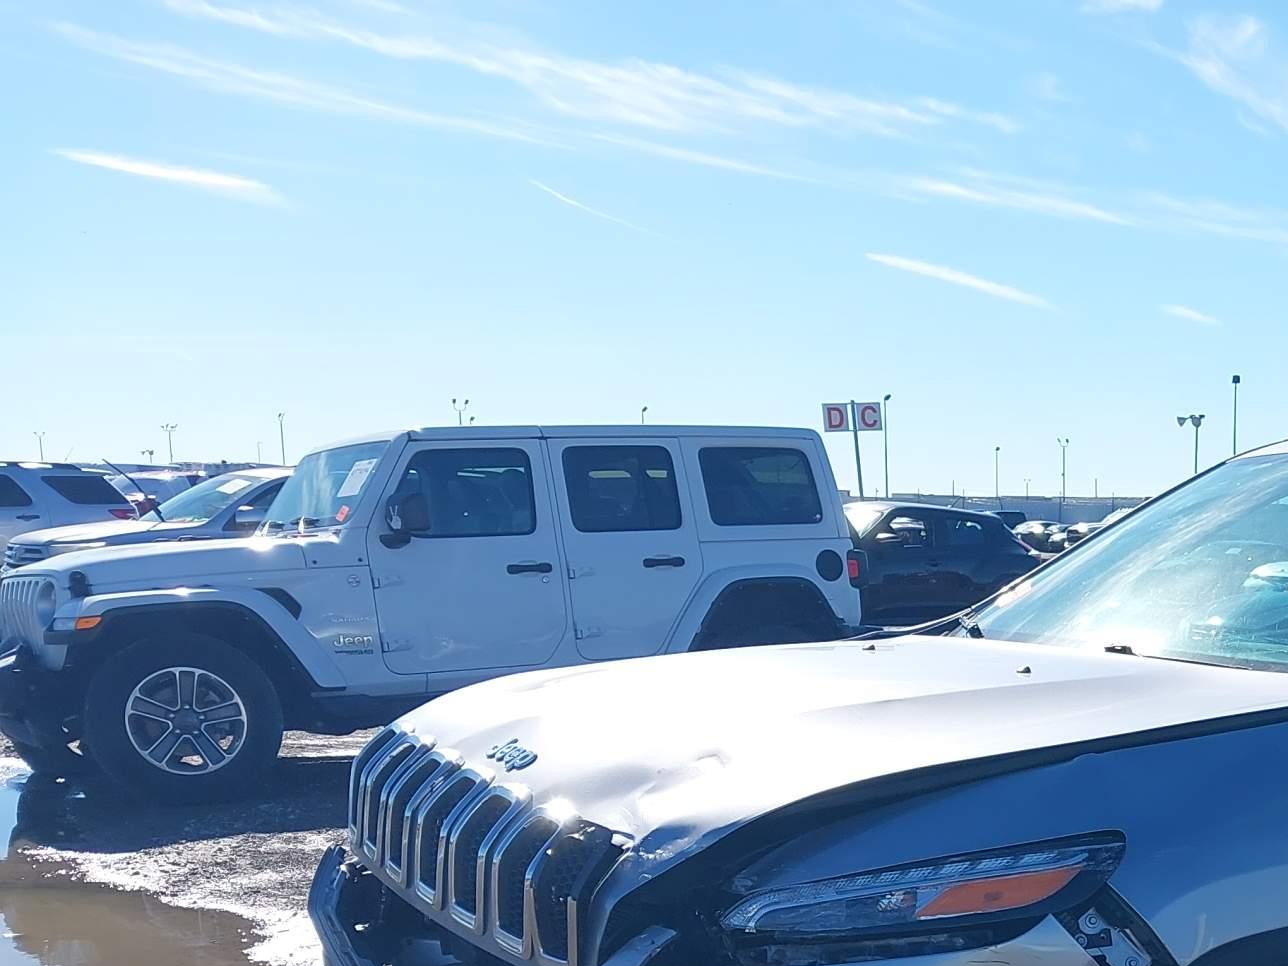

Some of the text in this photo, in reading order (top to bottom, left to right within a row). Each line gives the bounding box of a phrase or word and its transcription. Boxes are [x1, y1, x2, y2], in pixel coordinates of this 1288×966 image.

[826, 405, 878, 429] D C
[334, 634, 373, 648] Jeep
[486, 738, 538, 773] Jeep
